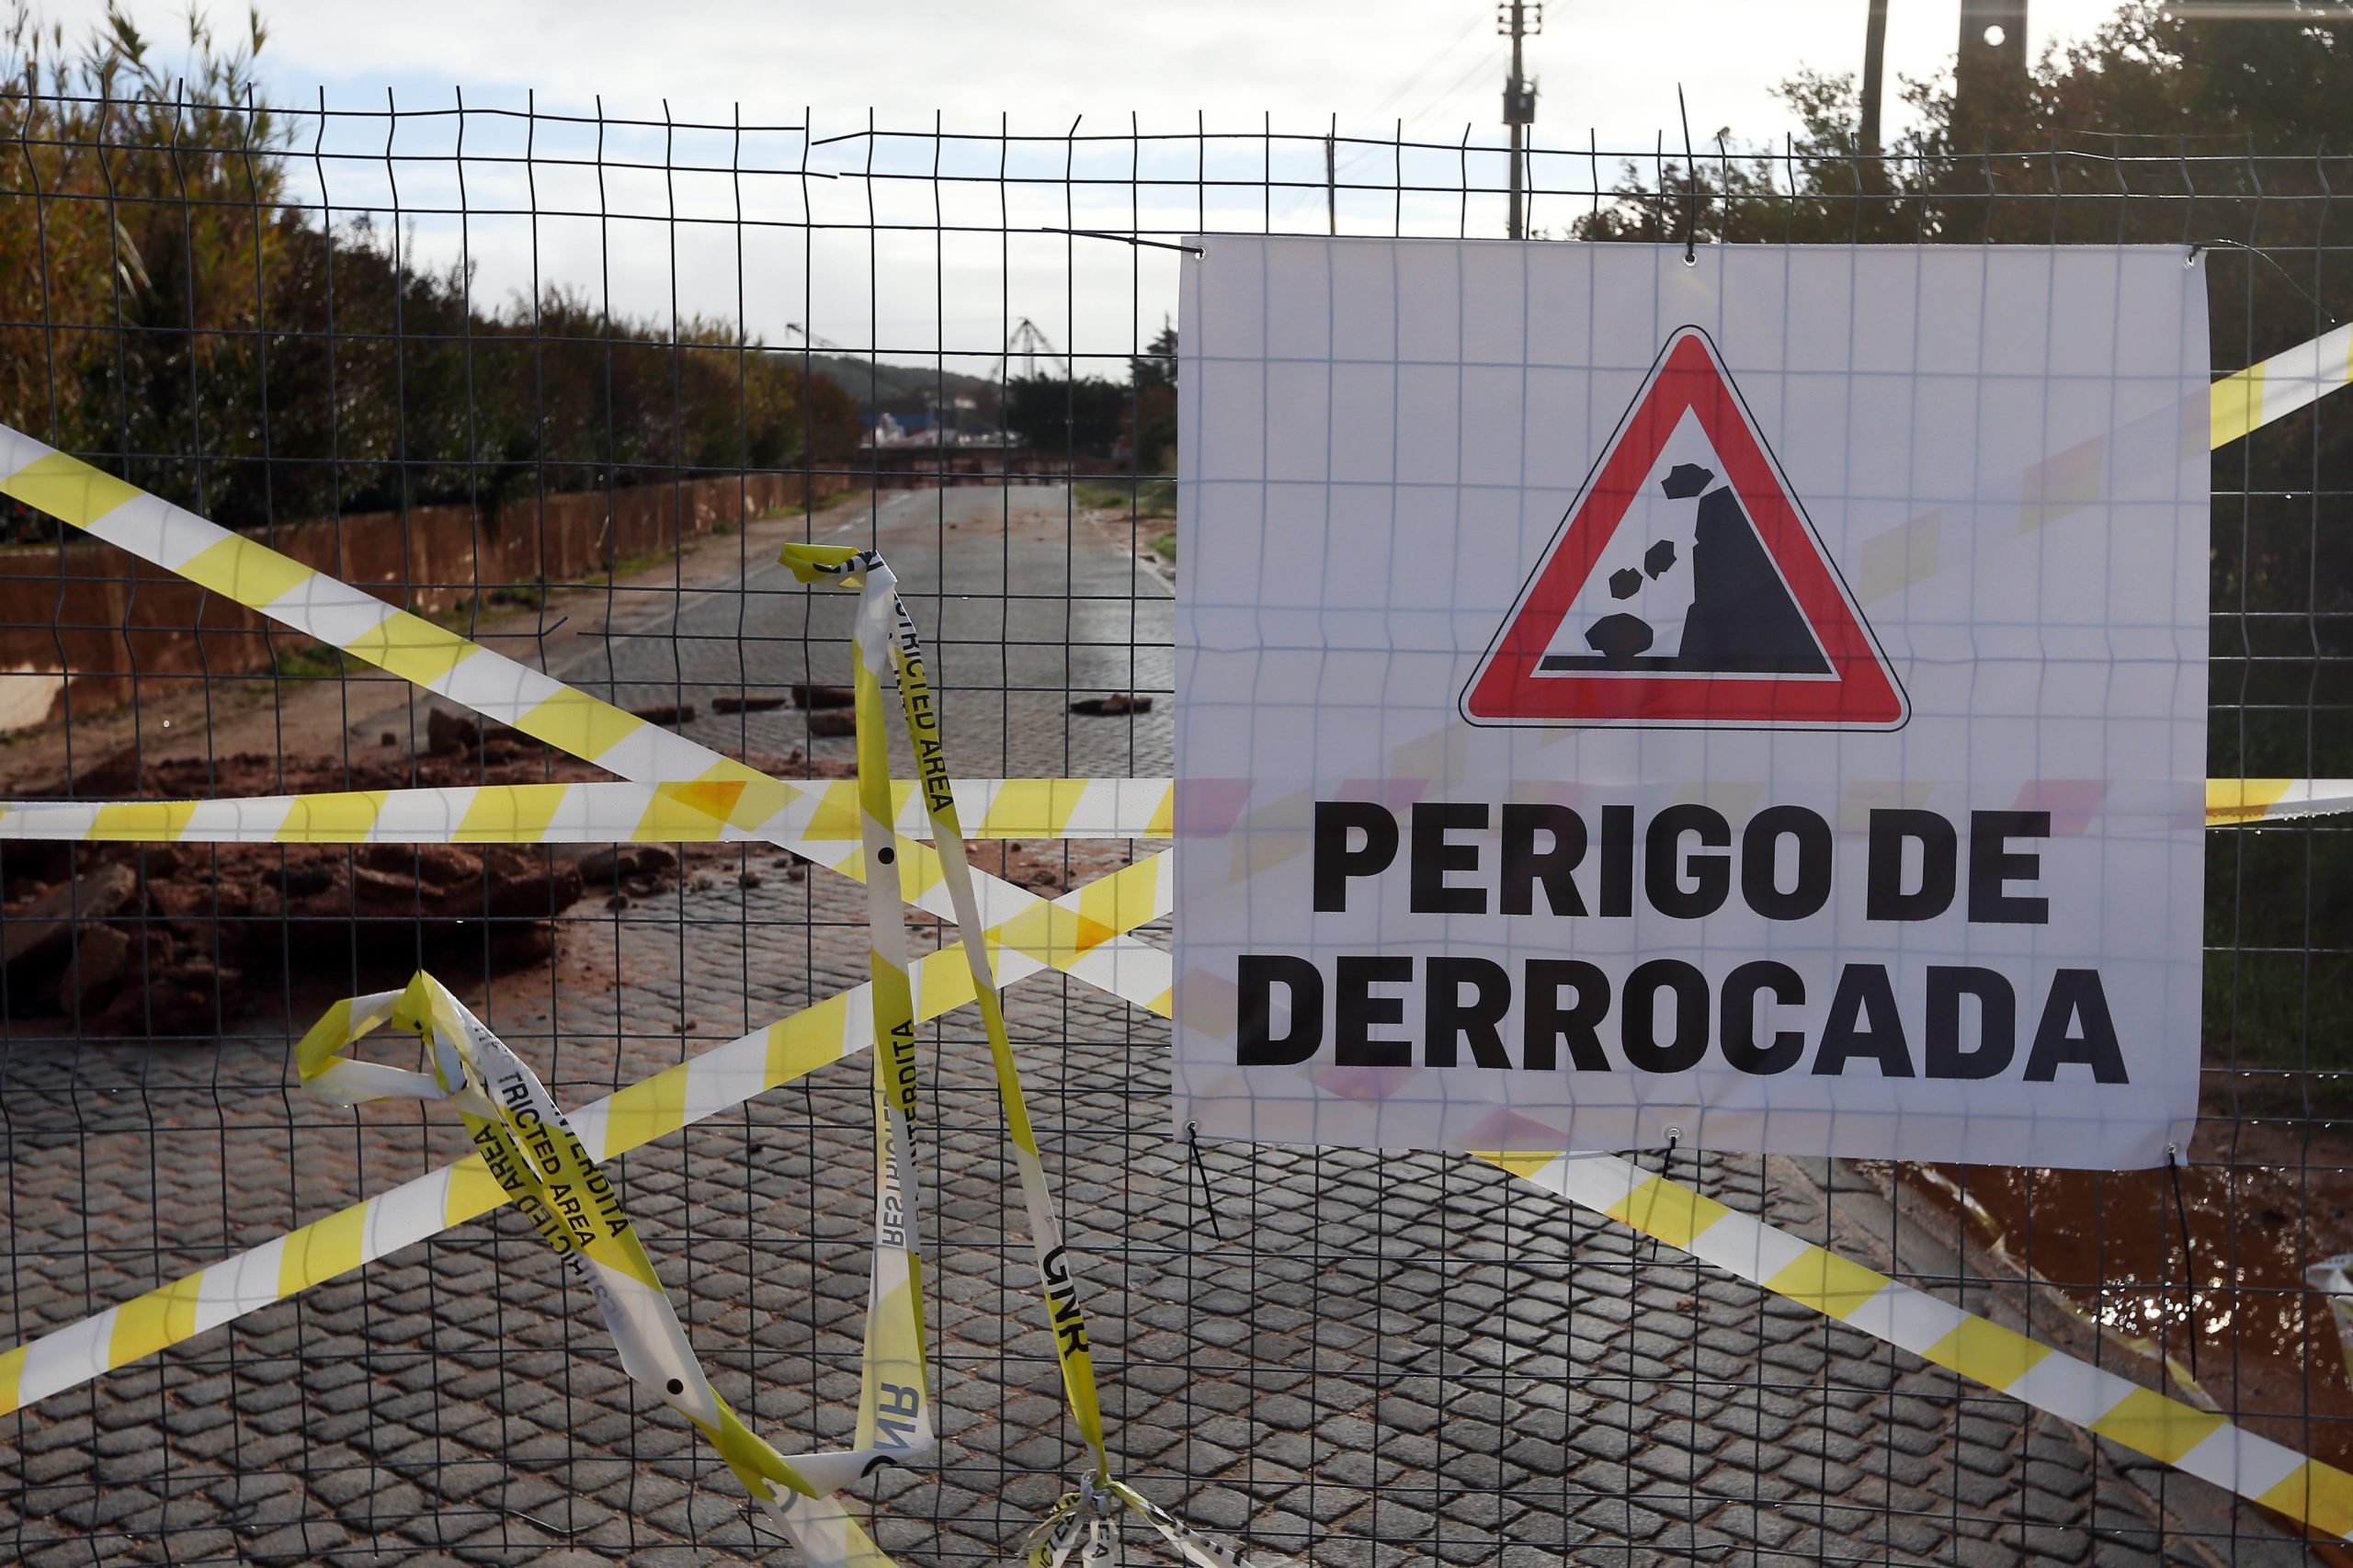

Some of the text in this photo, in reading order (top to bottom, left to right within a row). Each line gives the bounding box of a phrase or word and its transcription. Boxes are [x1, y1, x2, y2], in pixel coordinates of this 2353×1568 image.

[919, 738, 954, 813] AREA
[1313, 801, 2052, 925] PERIGO DE
[1236, 954, 2131, 1085] DERROCADA
[497, 1072, 561, 1175] TRICTED
[550, 1184, 597, 1248] AREA
